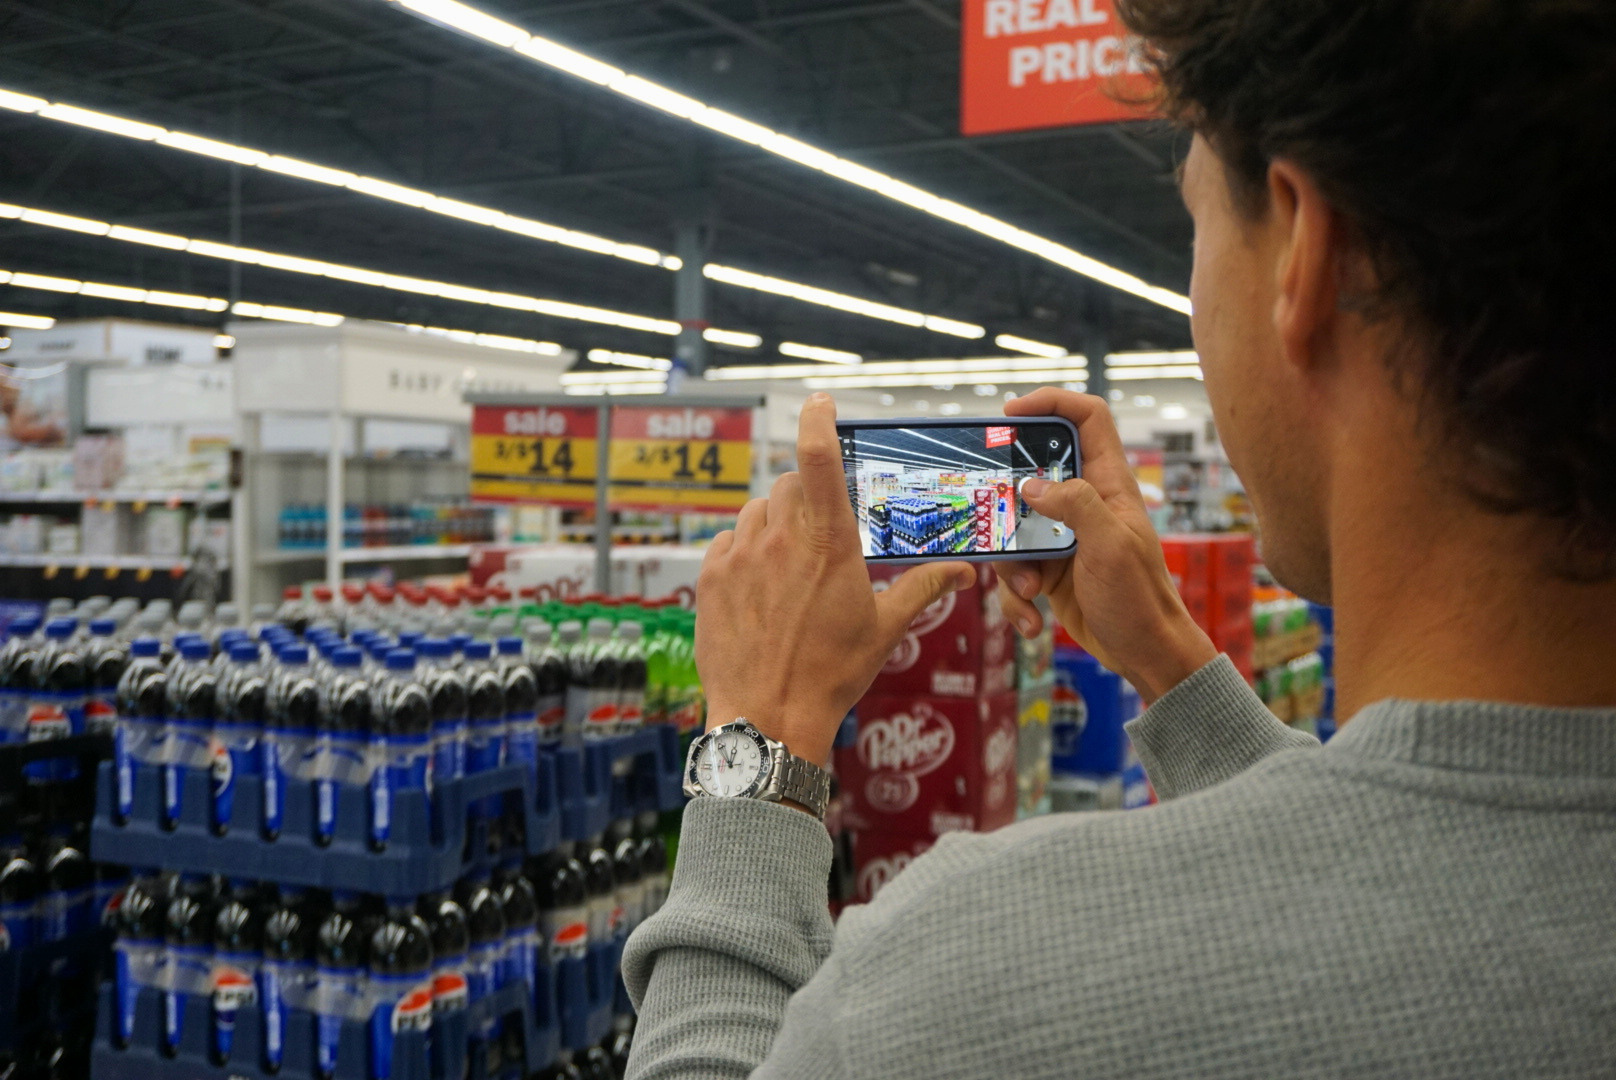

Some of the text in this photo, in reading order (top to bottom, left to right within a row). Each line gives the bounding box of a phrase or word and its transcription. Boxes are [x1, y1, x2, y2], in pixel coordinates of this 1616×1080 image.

[985, 0, 1107, 37] REAL
[504, 409, 566, 436] sale
[647, 409, 715, 438] sale
[744, 727, 759, 738] 20
